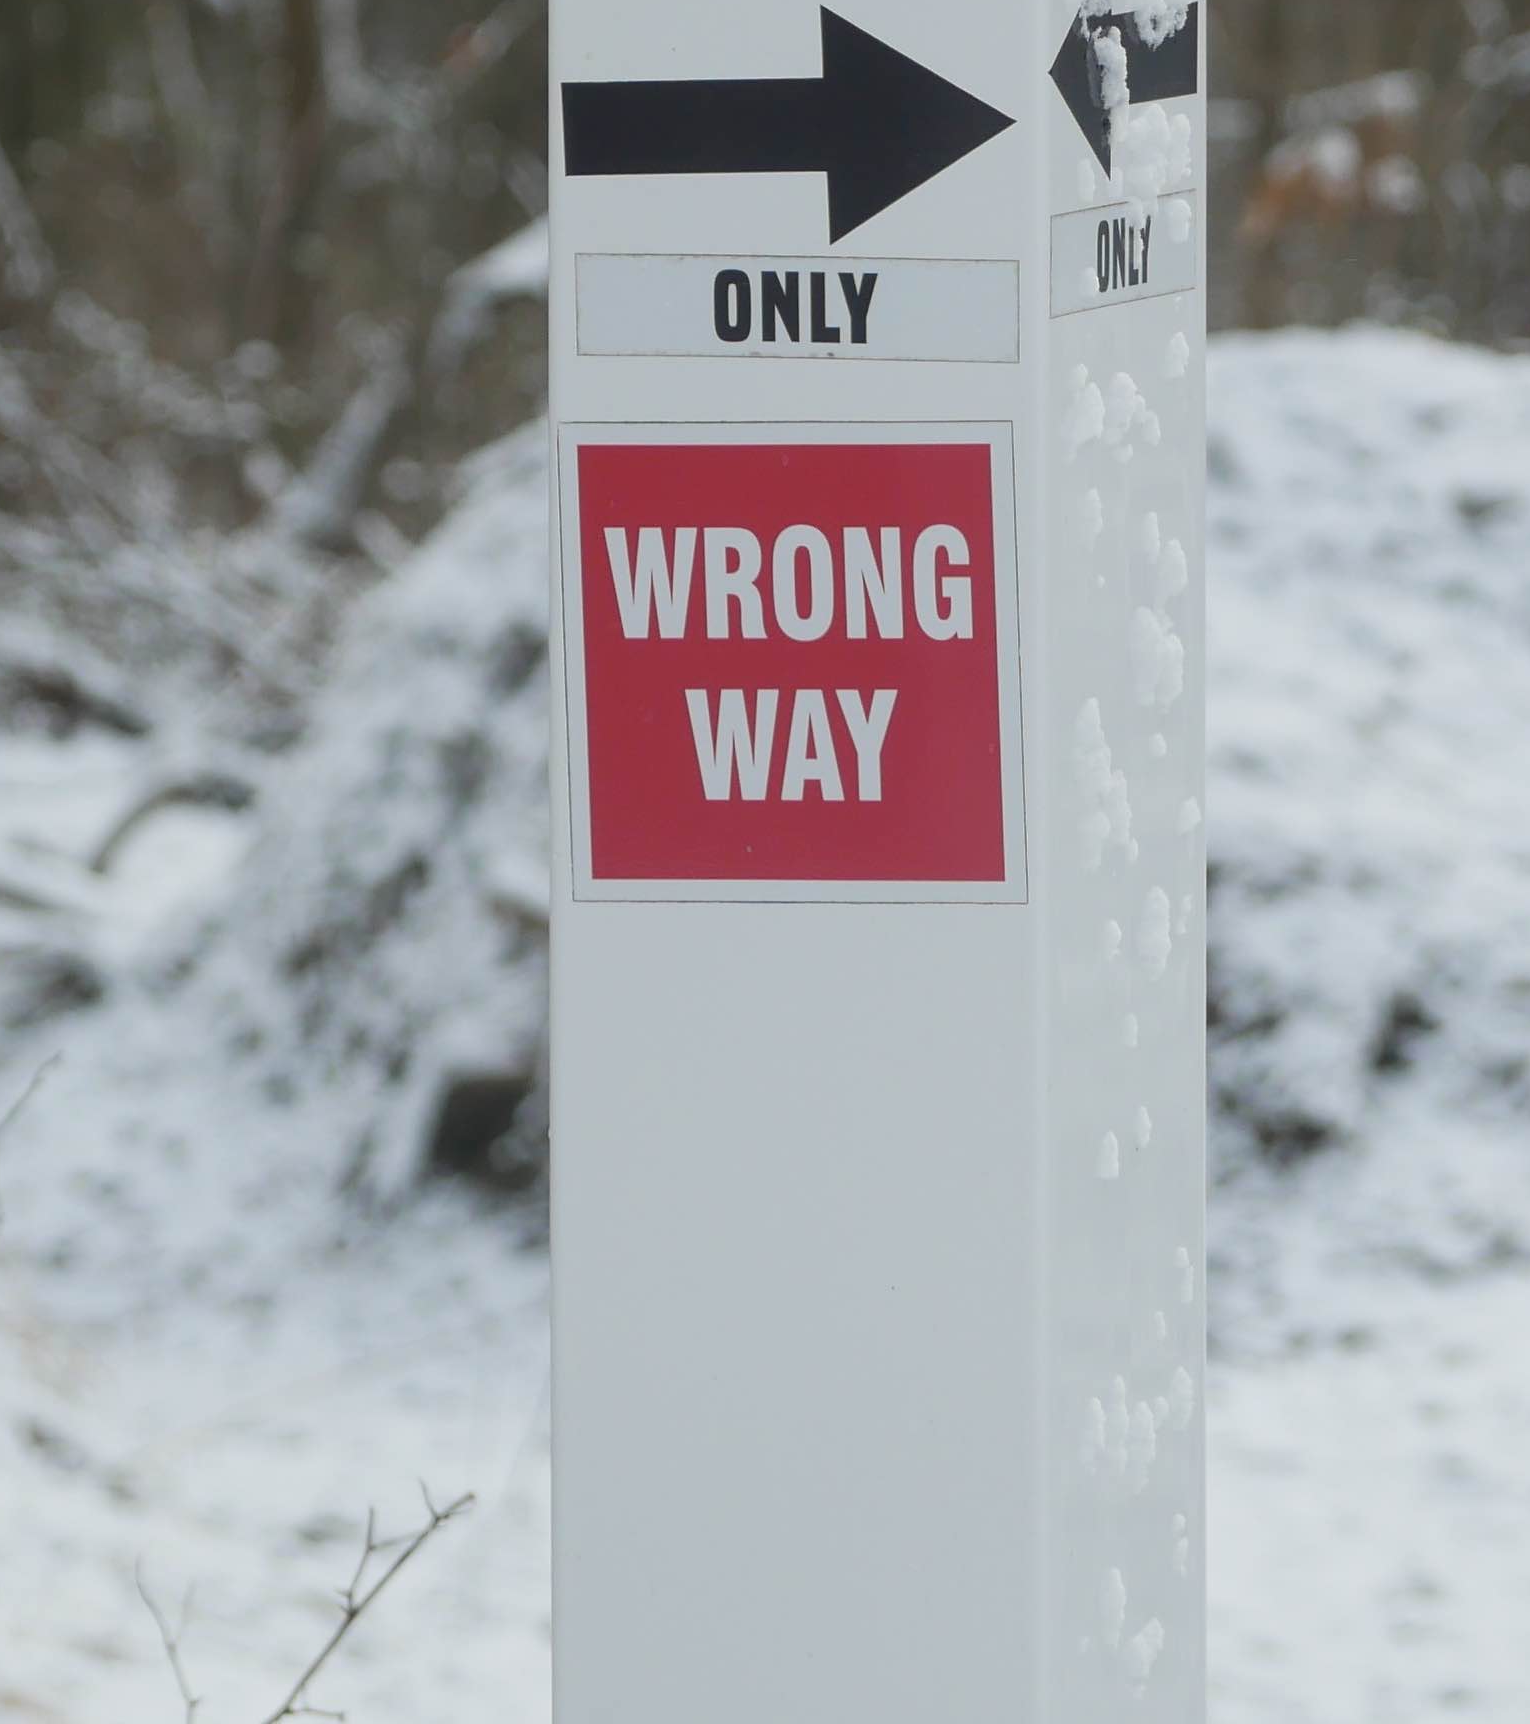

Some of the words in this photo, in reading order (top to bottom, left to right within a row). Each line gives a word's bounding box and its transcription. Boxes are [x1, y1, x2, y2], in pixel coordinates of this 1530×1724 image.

[1097, 214, 1151, 293] ONLY
[713, 269, 877, 344] ONLY
[603, 524, 974, 642] WRONG
[684, 689, 898, 802] WAY
